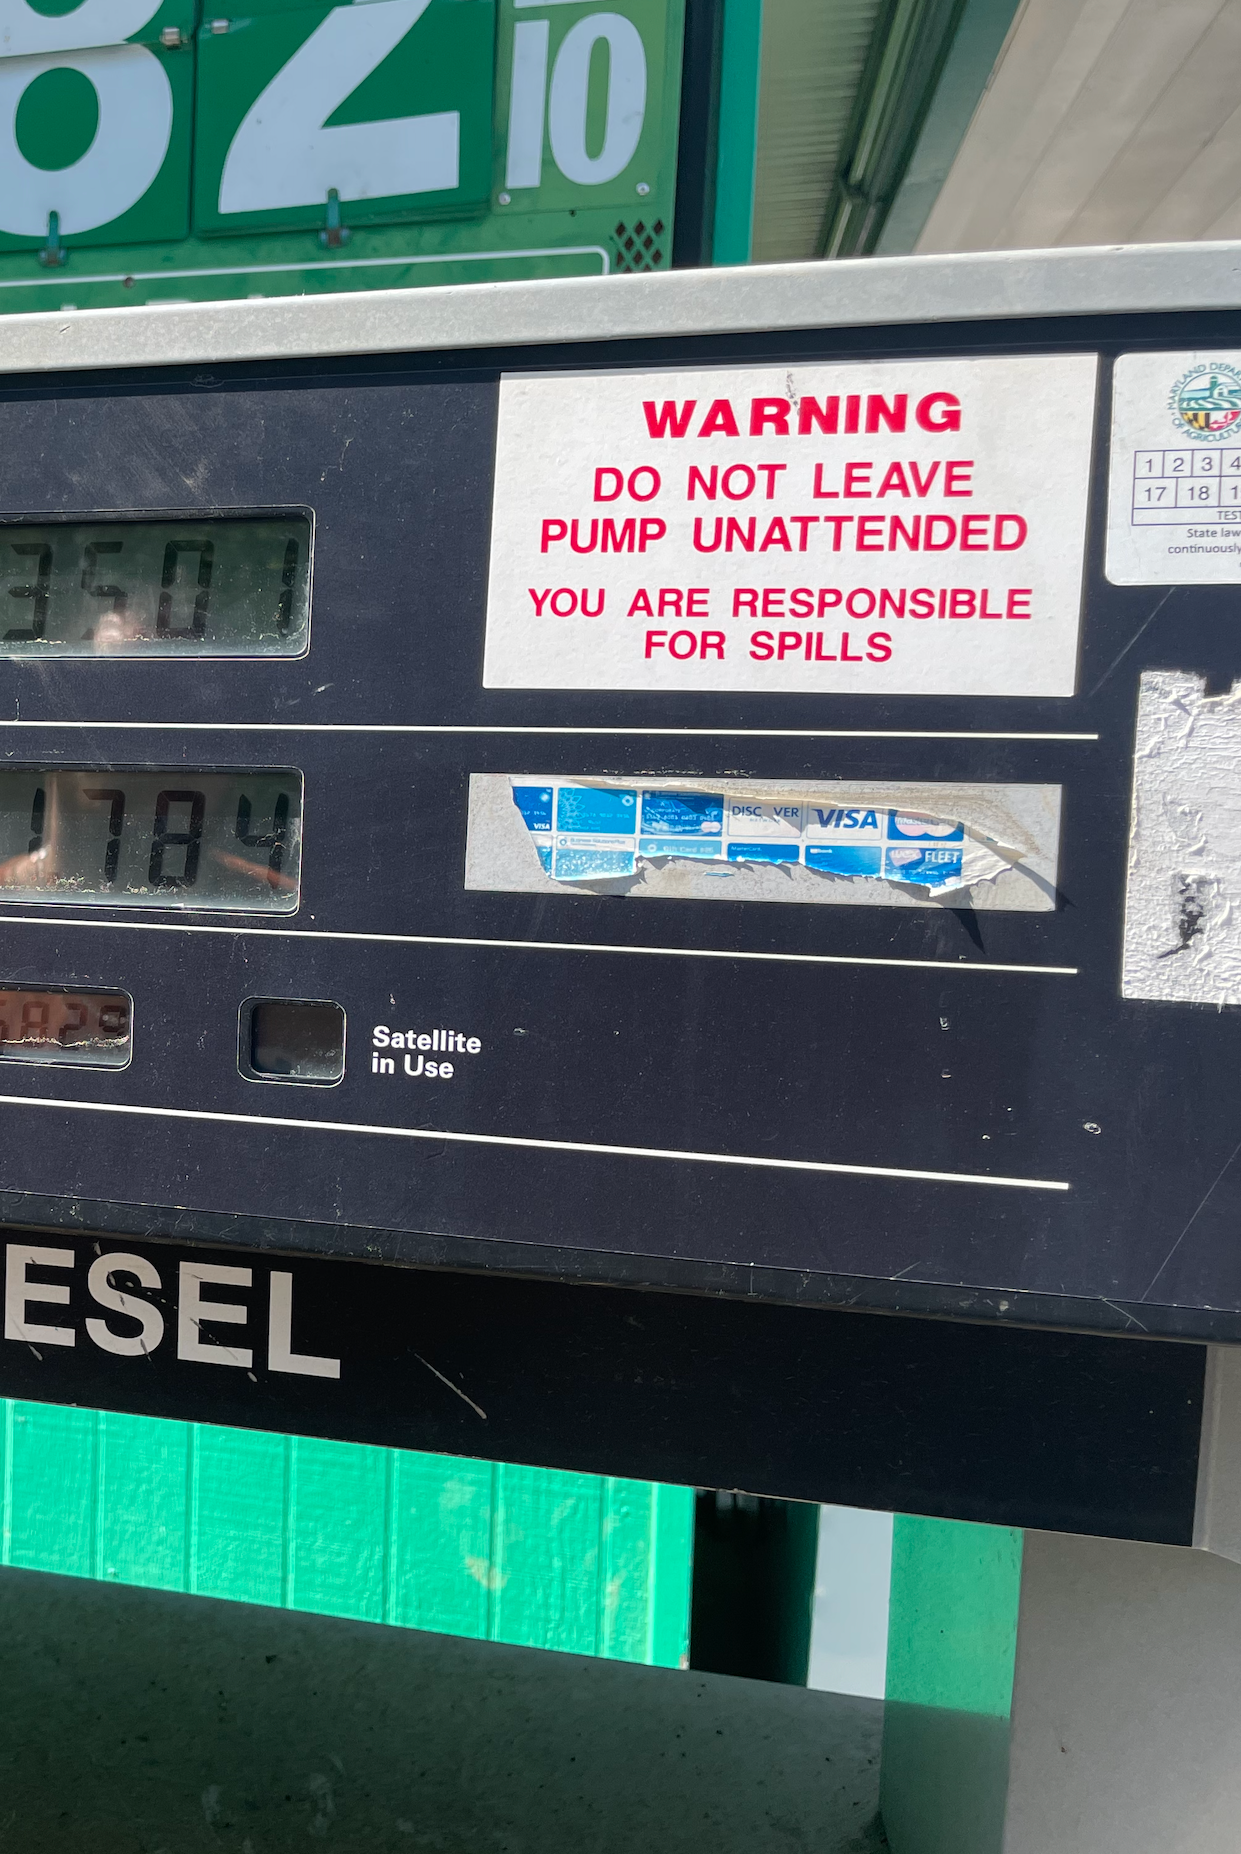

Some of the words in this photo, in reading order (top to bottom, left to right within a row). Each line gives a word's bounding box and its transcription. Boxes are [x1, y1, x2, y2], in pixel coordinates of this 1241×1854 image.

[505, 12, 647, 190] 10
[1167, 364, 1207, 410] MARYLAND
[643, 392, 962, 439] WARNING
[1145, 458, 1153, 473] 1
[1172, 457, 1185, 472] 2
[1201, 456, 1213, 472] 3
[1230, 456, 1241, 471] 4
[594, 466, 661, 502] DO
[687, 464, 787, 501] NOT
[813, 460, 975, 499] LEAVE
[1144, 486, 1167, 502] 17
[1187, 485, 1211, 501] 18
[540, 518, 667, 554] PUMP
[693, 513, 1028, 553] UNATTENDED
[1187, 528, 1218, 539] State
[1221, 527, 1241, 538] law
[1168, 543, 1241, 555] continuously
[528, 588, 605, 618] YOU
[627, 588, 710, 618] ARE
[731, 588, 1033, 620] RESPONSIBLE
[644, 631, 726, 660] FOR
[749, 631, 893, 662] SPILLS
[812, 808, 878, 829] VISA
[925, 850, 960, 864] FLEET
[372, 1025, 482, 1054] Satellite
[371, 1051, 395, 1074] in
[404, 1053, 454, 1079] Use
